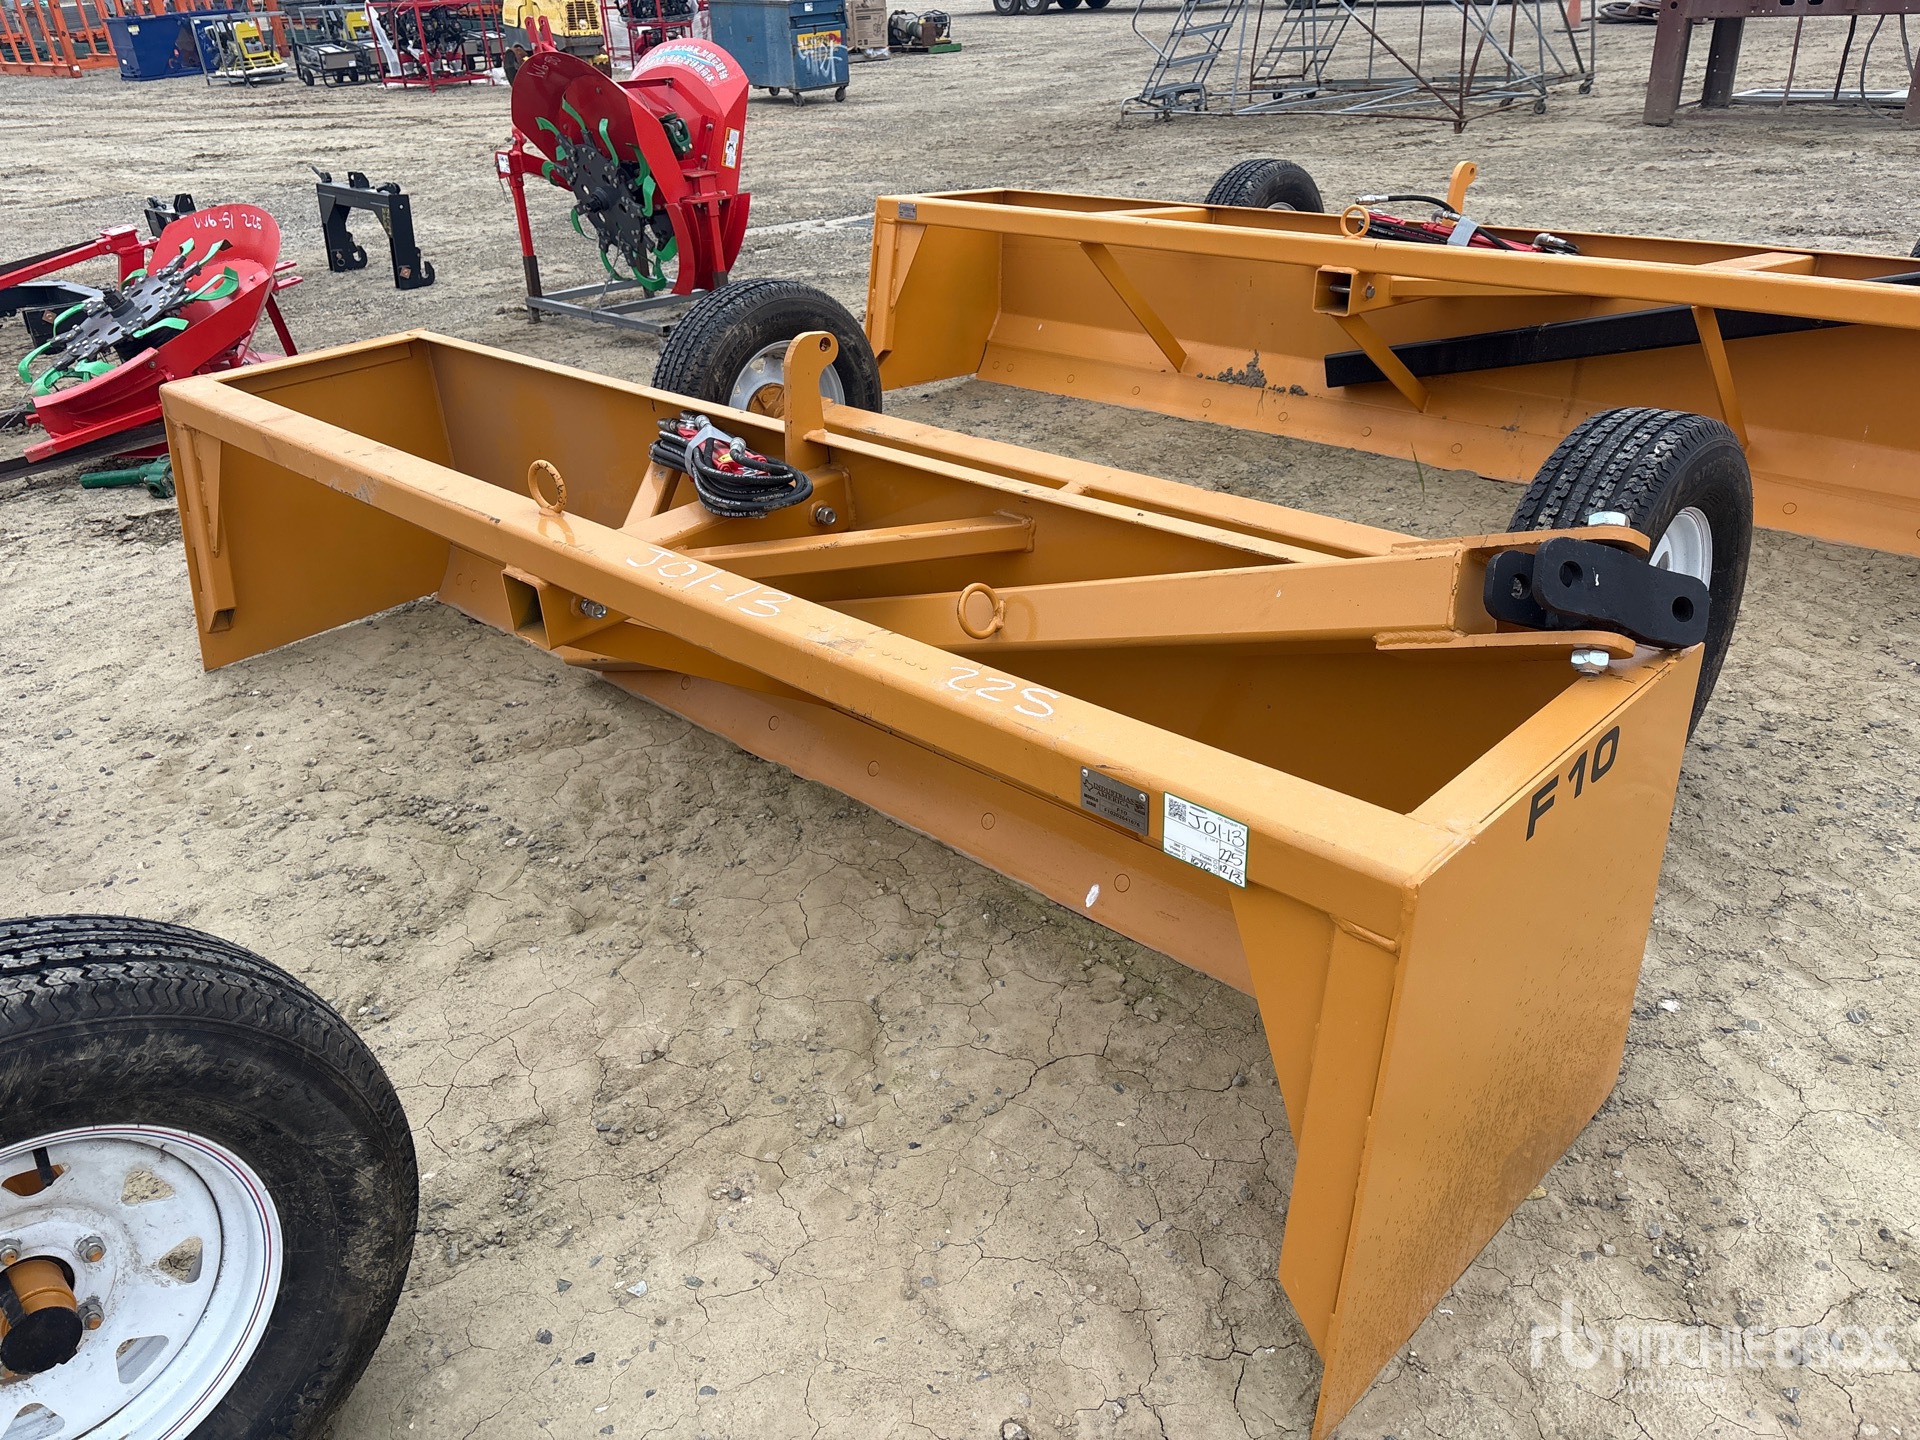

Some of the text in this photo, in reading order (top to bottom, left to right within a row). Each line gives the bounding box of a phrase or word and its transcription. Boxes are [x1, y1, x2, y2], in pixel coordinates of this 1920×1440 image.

[626, 547, 793, 618] J01-13
[1093, 783, 1134, 805] INDUSTRIAS
[1097, 791, 1130, 808] AMERICA
[1188, 811, 1245, 848] J01-13
